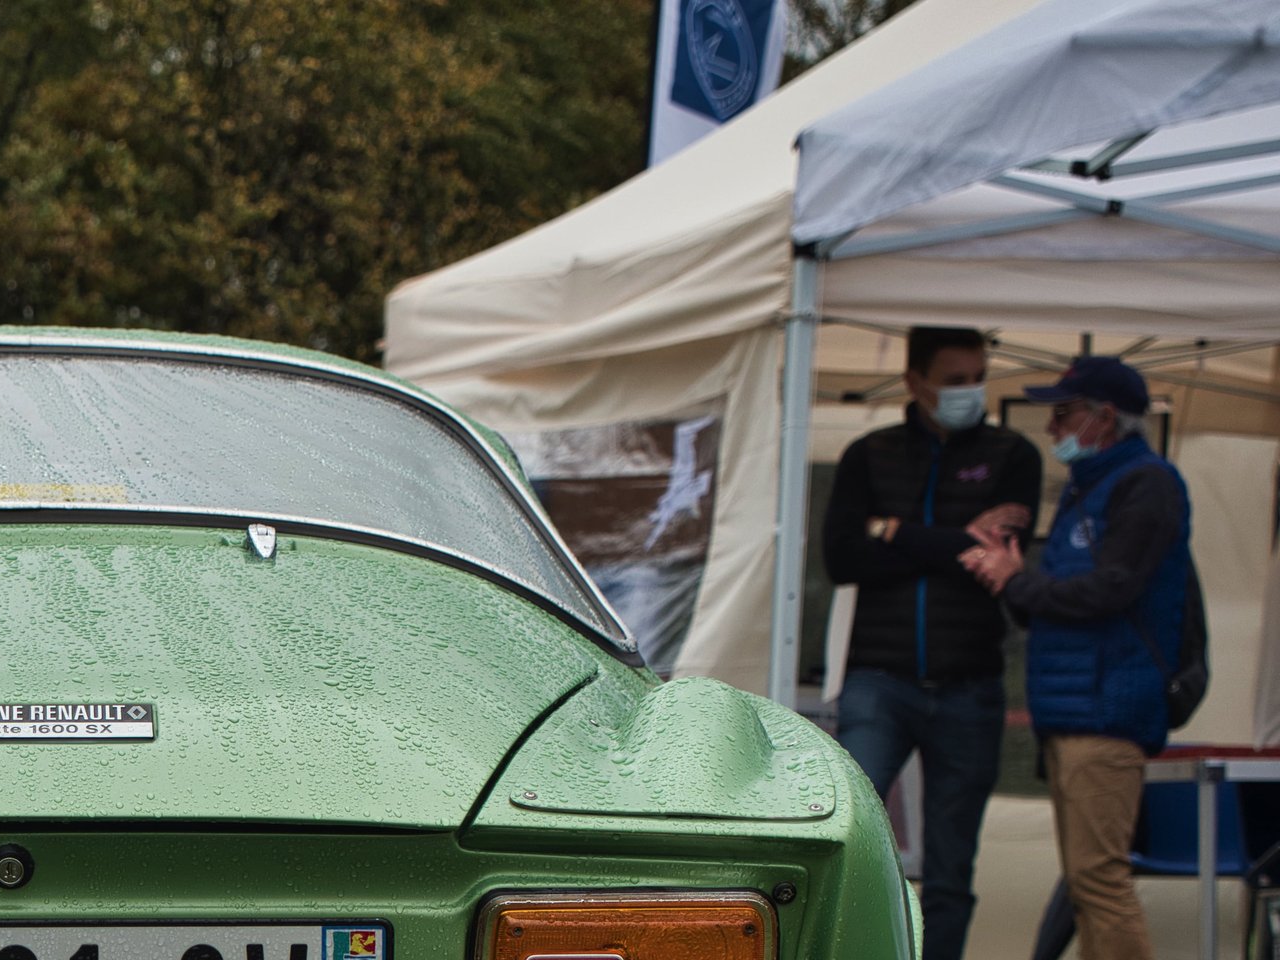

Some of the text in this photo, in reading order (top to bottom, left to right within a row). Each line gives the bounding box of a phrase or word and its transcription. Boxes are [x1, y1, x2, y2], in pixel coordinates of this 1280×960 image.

[30, 704, 125, 720] RENAULT
[30, 724, 78, 734] 1600
[85, 724, 113, 734] SX
